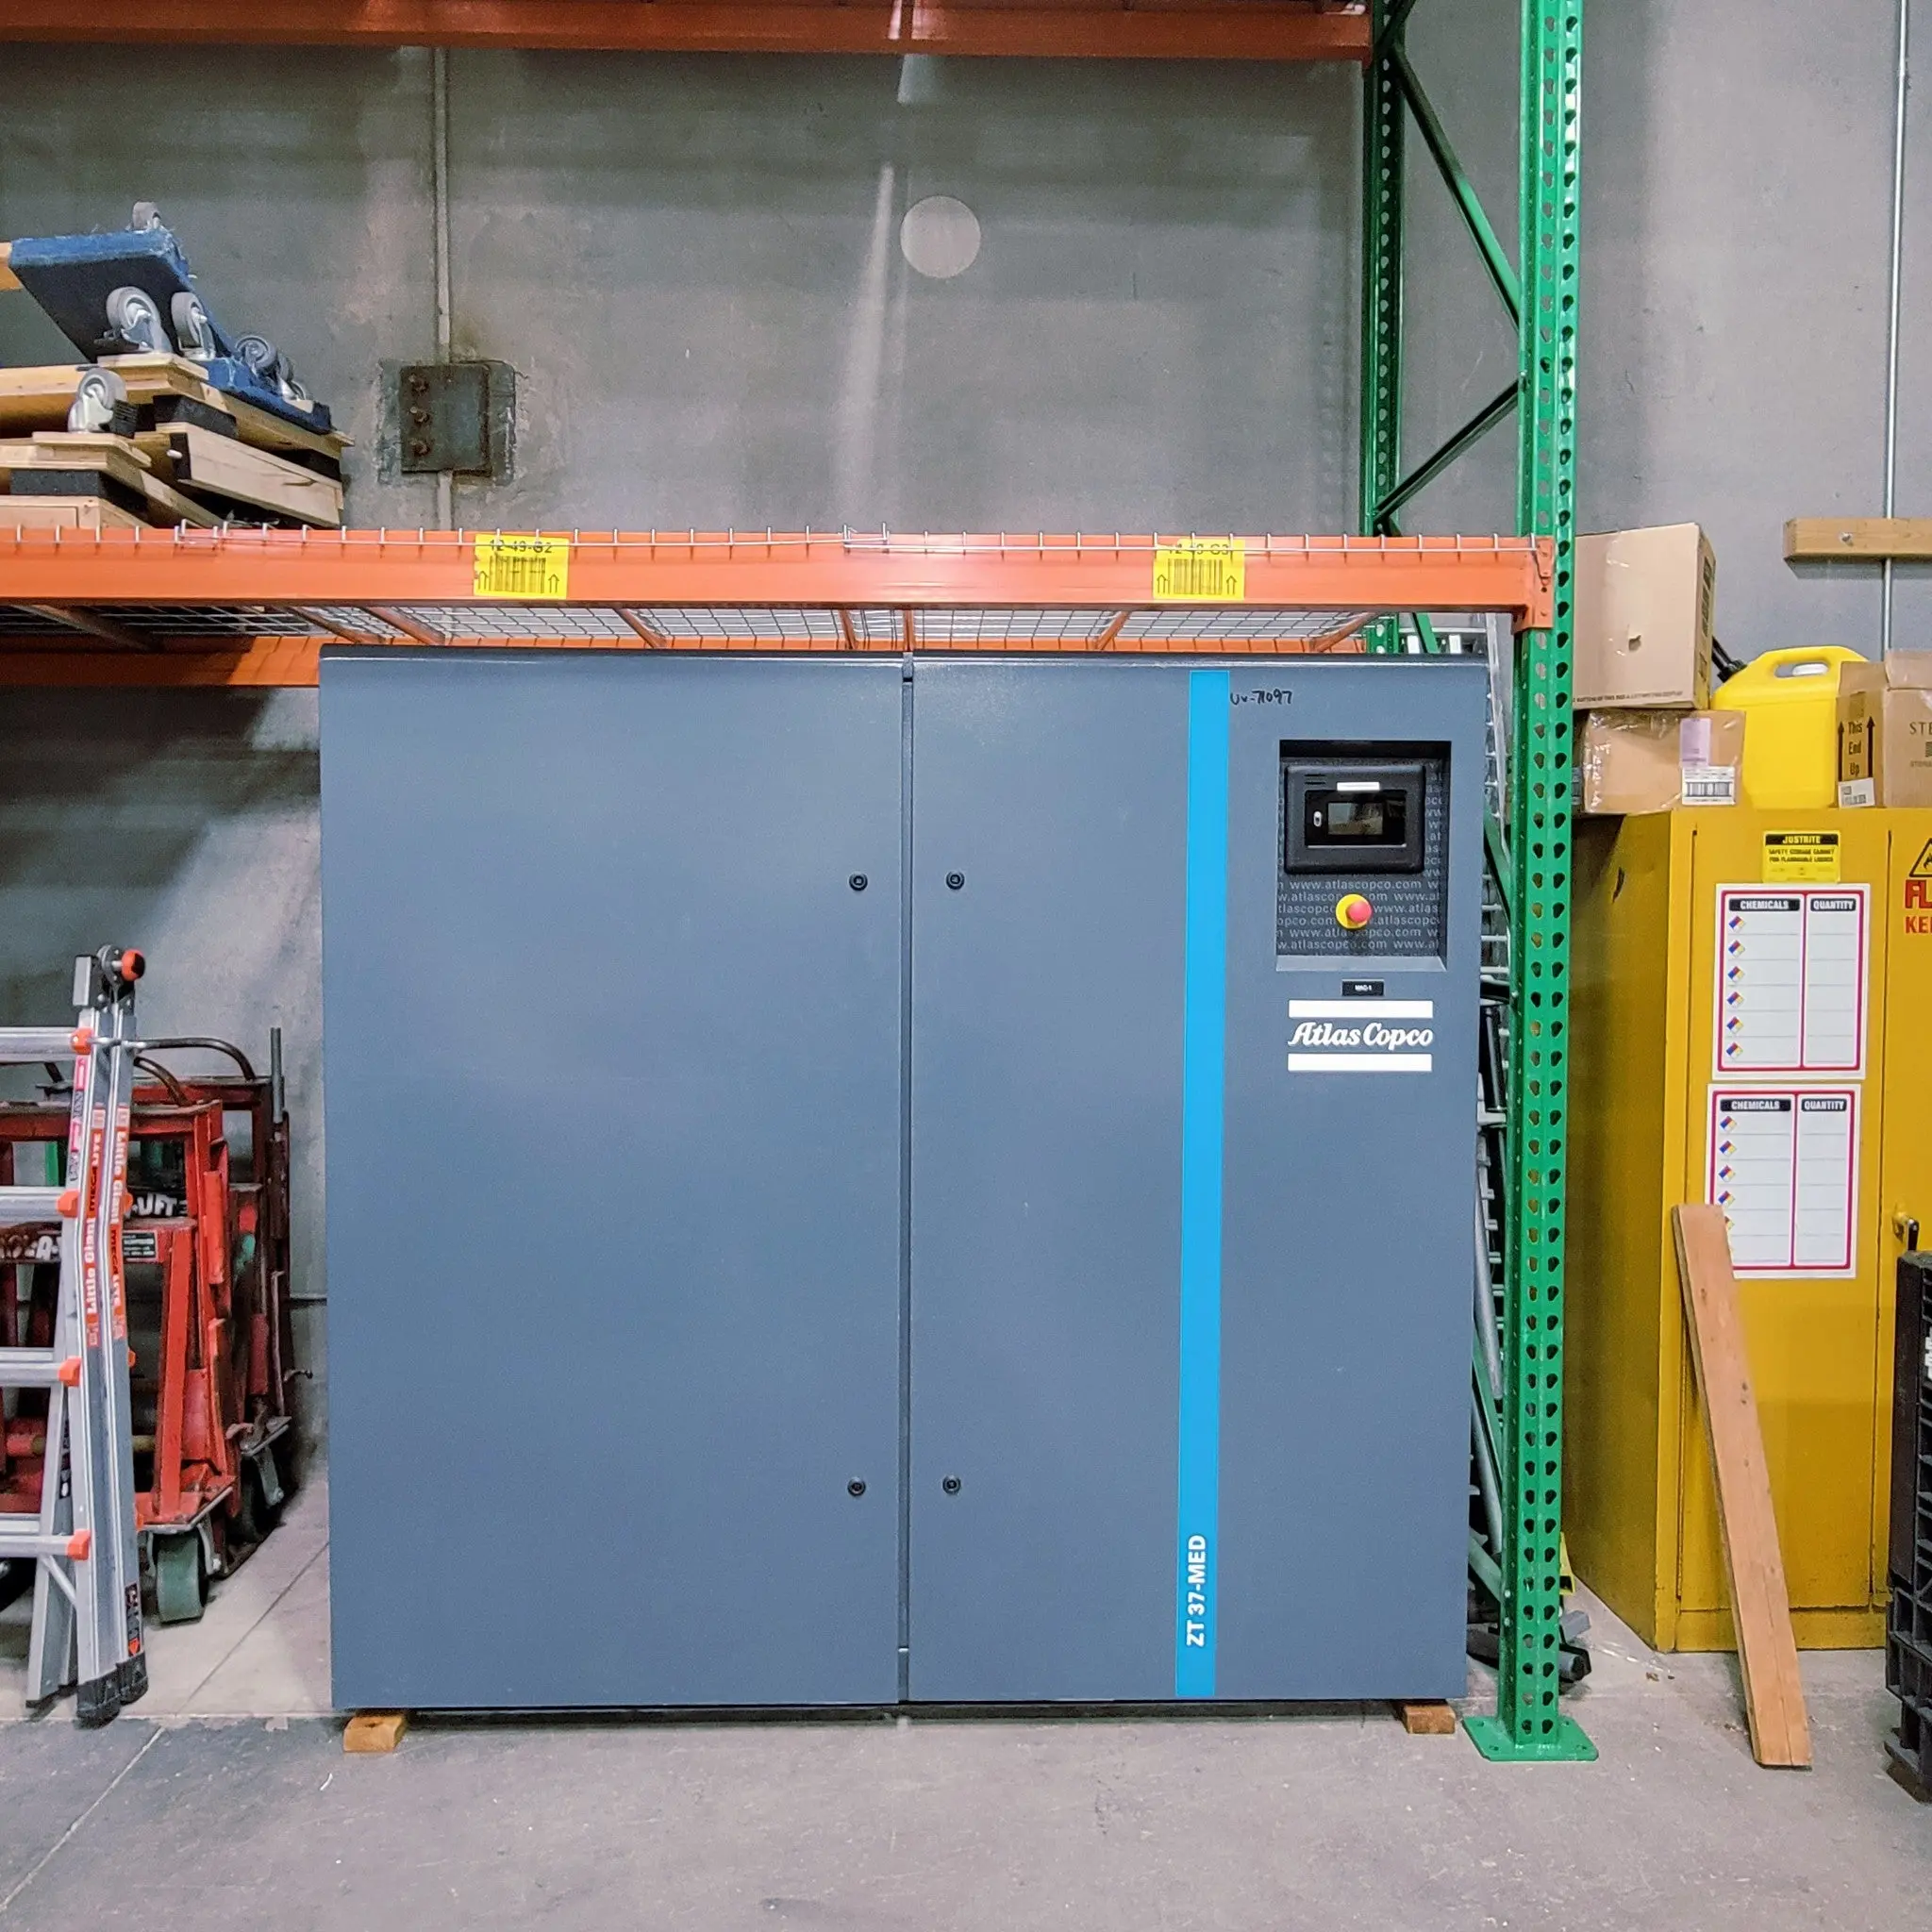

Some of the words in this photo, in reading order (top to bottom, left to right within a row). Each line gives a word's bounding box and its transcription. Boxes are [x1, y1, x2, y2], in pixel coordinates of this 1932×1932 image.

[1848, 722, 1863, 734] This
[1849, 740, 1861, 755] End
[1849, 762, 1859, 776] Up
[1290, 880, 1422, 890] www.atlascopco.com
[1740, 900, 1790, 910] CHEMICALS
[1813, 900, 1854, 910] QUANTITY
[1288, 1022, 1361, 1046] Atlas
[1363, 1022, 1434, 1050] Copco
[1731, 1100, 1780, 1110] CHEMICALS
[1804, 1100, 1844, 1110] QUANTITY
[114, 1131, 126, 1176] Little
[110, 1180, 124, 1226] Giant
[84, 1217, 95, 1263] Giant
[86, 1268, 97, 1314] Little
[1187, 1534, 1207, 1616] 37-MED
[1186, 1619, 1205, 1647] ZT
